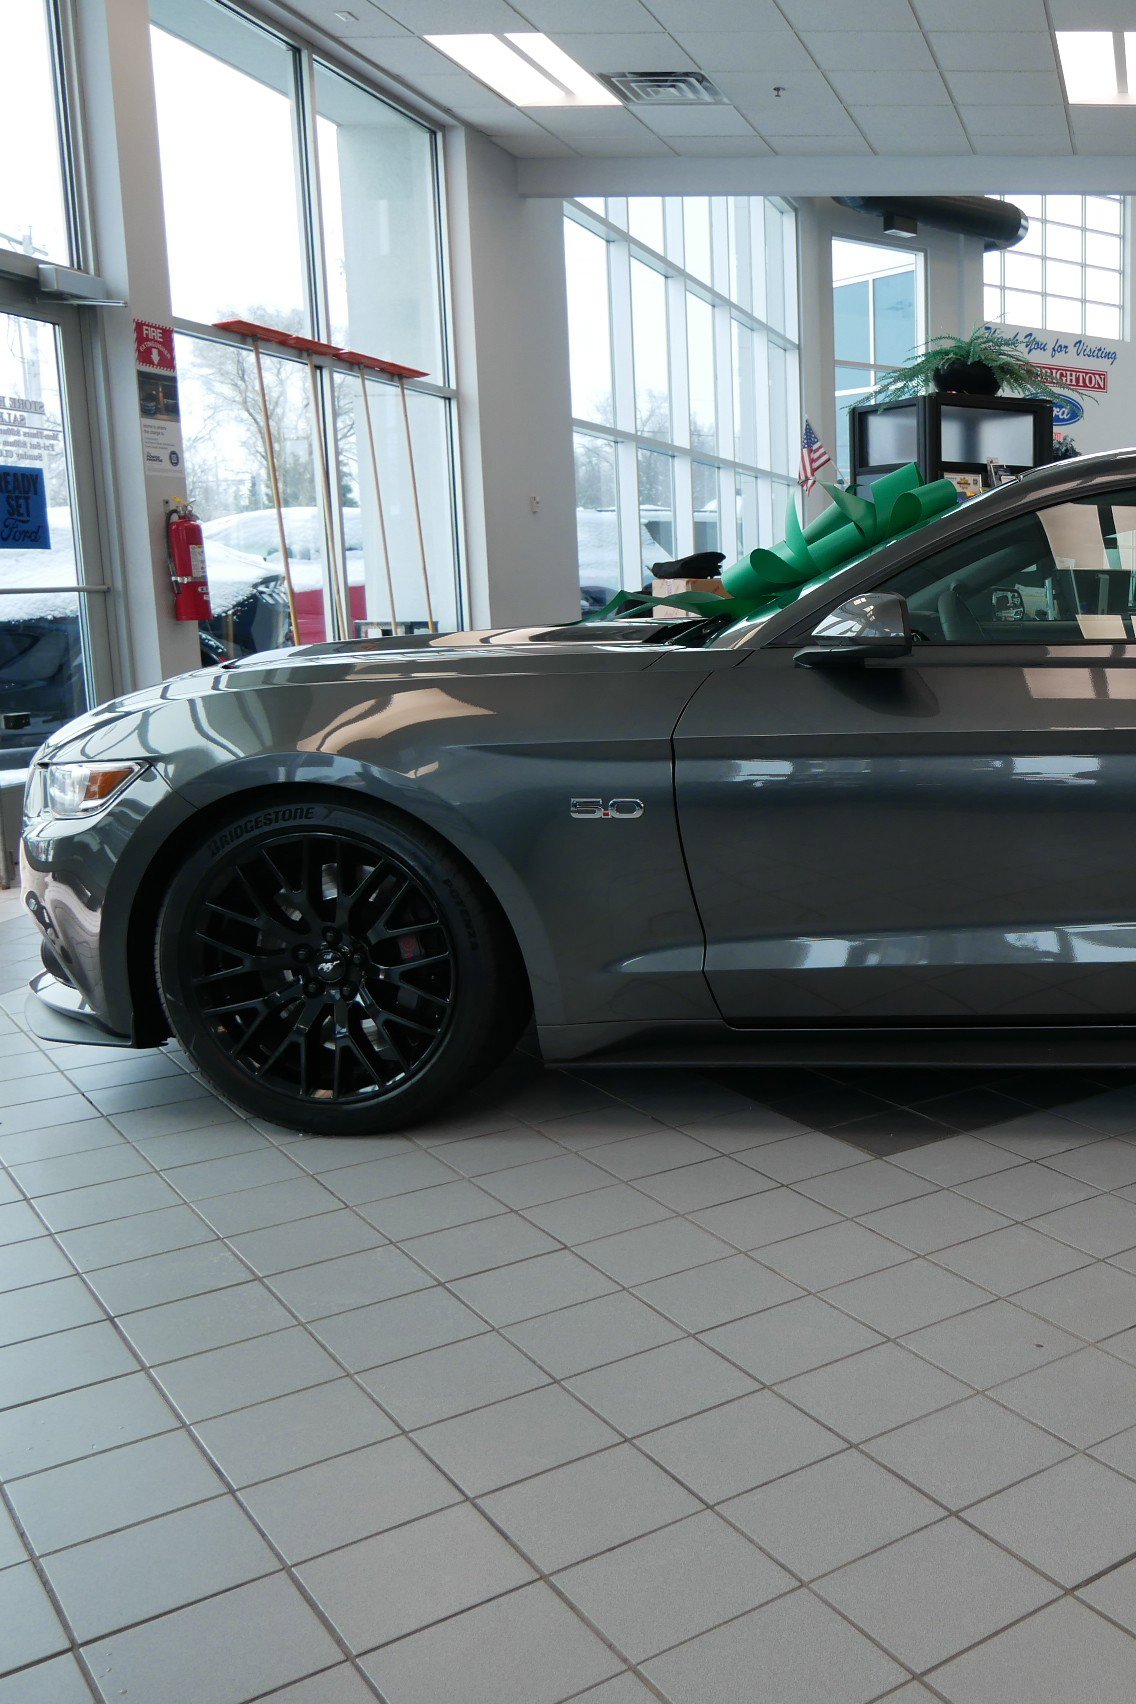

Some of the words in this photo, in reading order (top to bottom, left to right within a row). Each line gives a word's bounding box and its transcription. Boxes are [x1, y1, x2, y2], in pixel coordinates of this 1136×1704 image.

[143, 325, 164, 342] FIRE
[1024, 333, 1048, 355] You
[1051, 338, 1069, 358] for
[1074, 339, 1118, 366] Visiting
[6, 494, 32, 518] SET
[0, 516, 43, 543] Ford
[570, 797, 645, 819] 5.0
[207, 806, 316, 858] BRIDGESTONE
